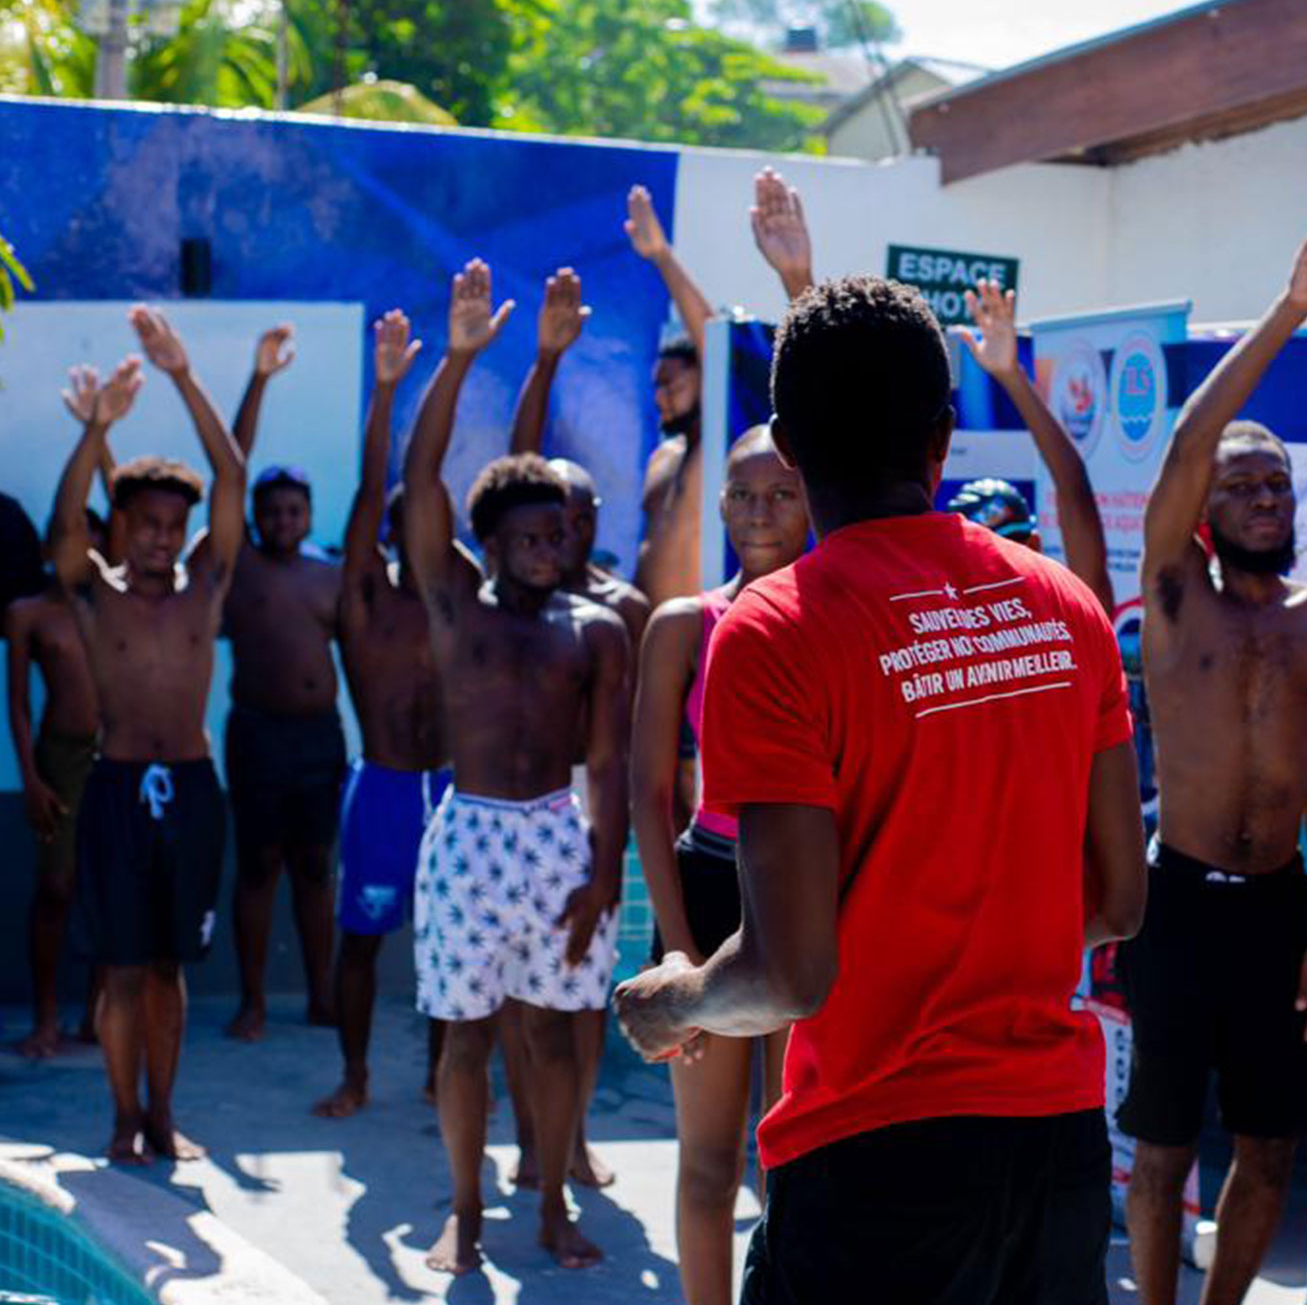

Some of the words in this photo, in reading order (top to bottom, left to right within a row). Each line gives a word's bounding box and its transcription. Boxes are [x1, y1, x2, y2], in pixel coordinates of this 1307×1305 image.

[899, 253, 1006, 283] ESPACE
[990, 597, 1032, 622] VIES,
[946, 667, 965, 692] UN
